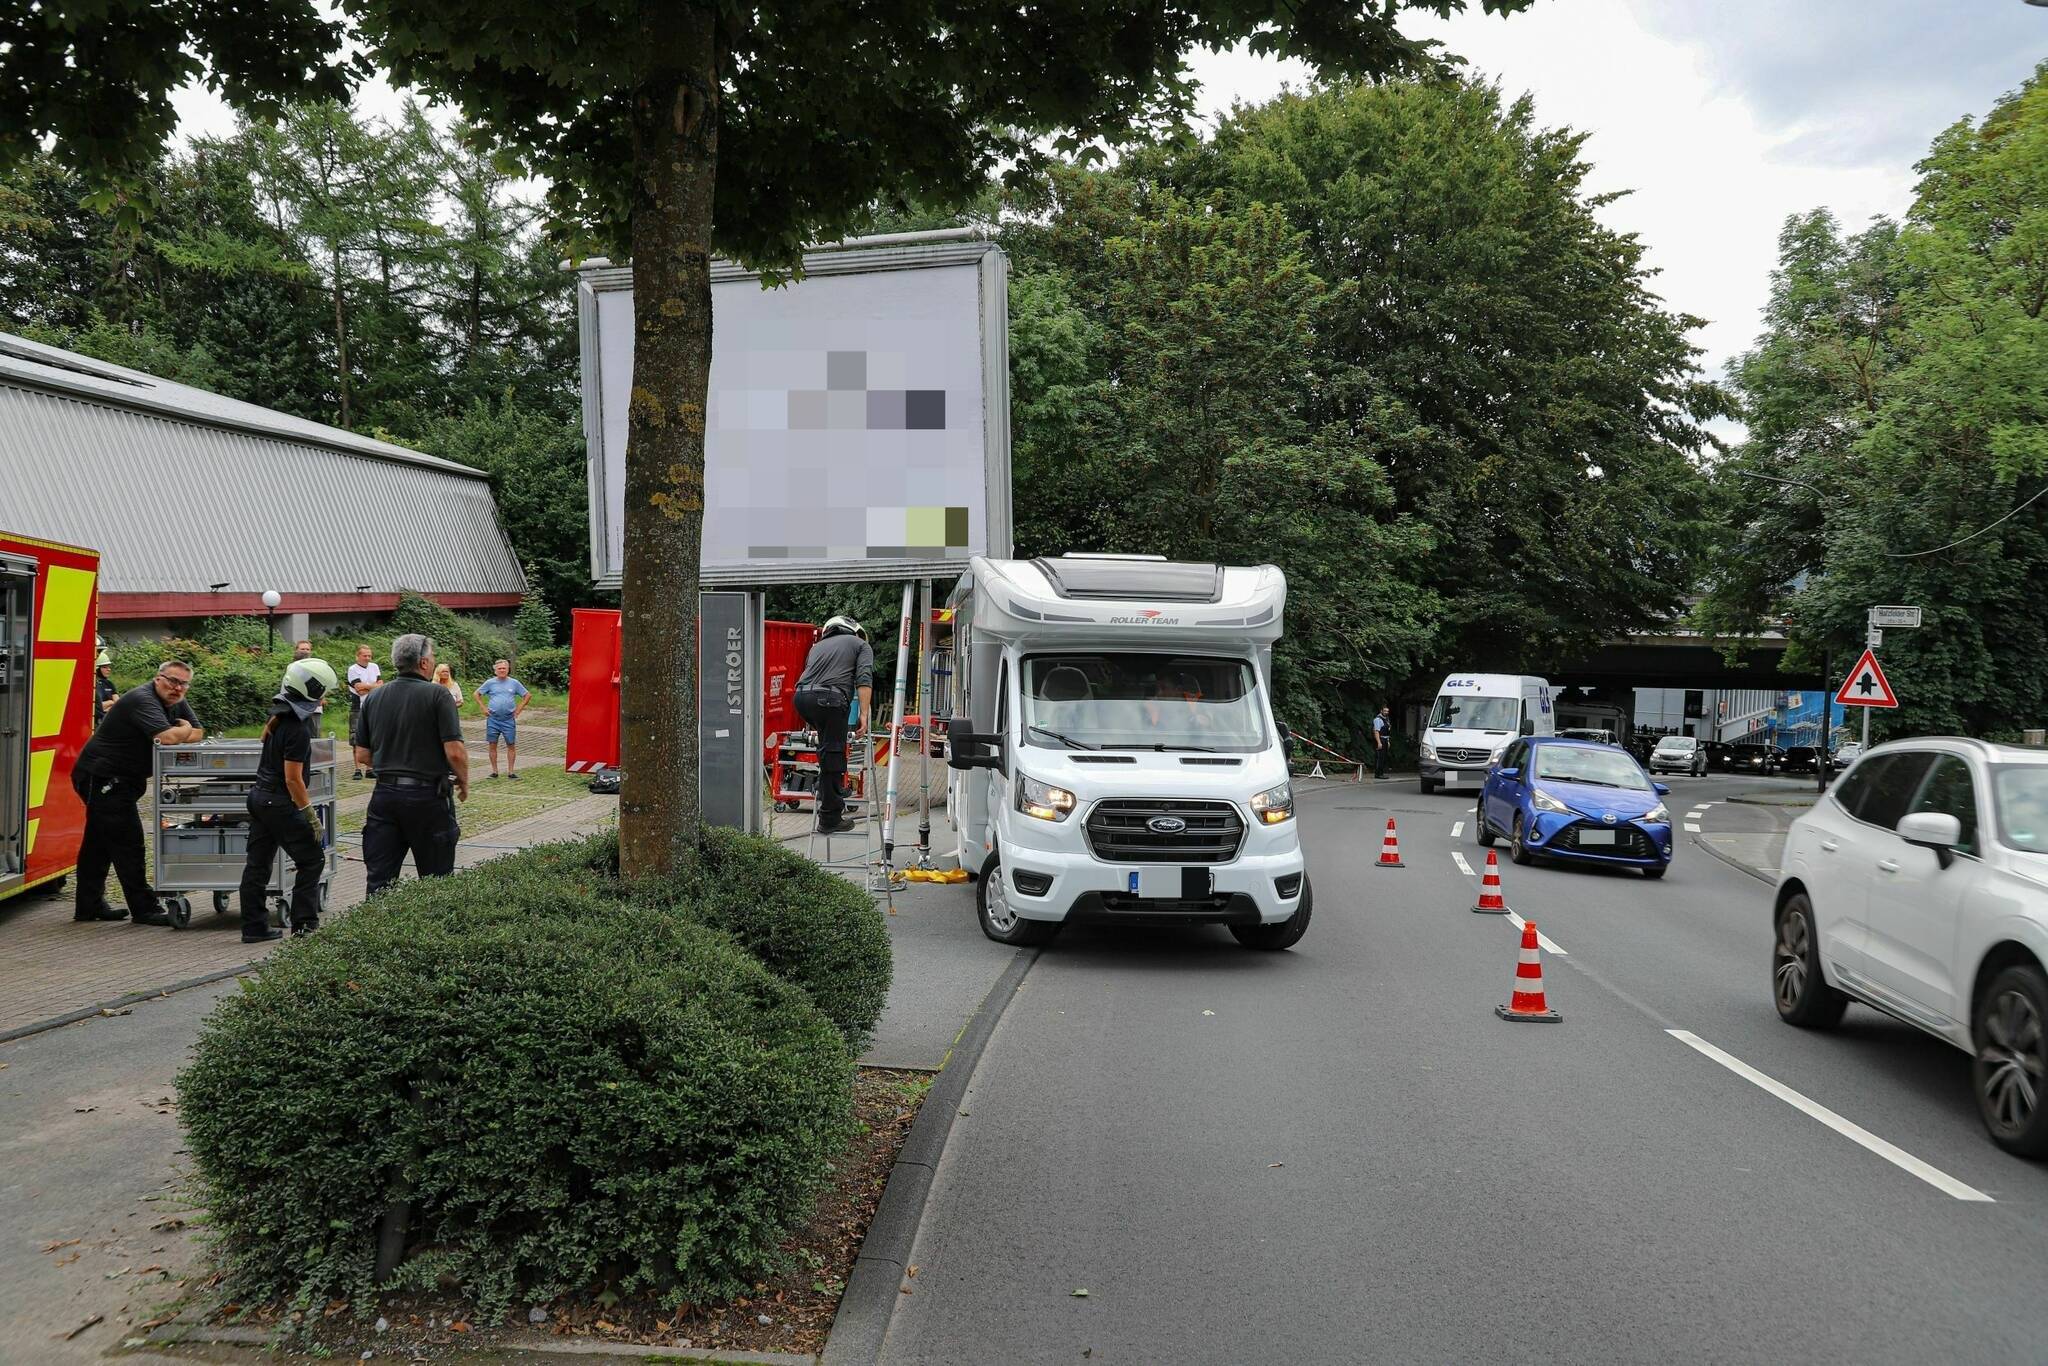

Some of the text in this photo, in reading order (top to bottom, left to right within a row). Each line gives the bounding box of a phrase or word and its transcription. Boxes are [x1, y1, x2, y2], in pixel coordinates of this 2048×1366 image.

[1110, 616, 1179, 625] ROLLER TEAM
[1447, 679, 1475, 687] GLS
